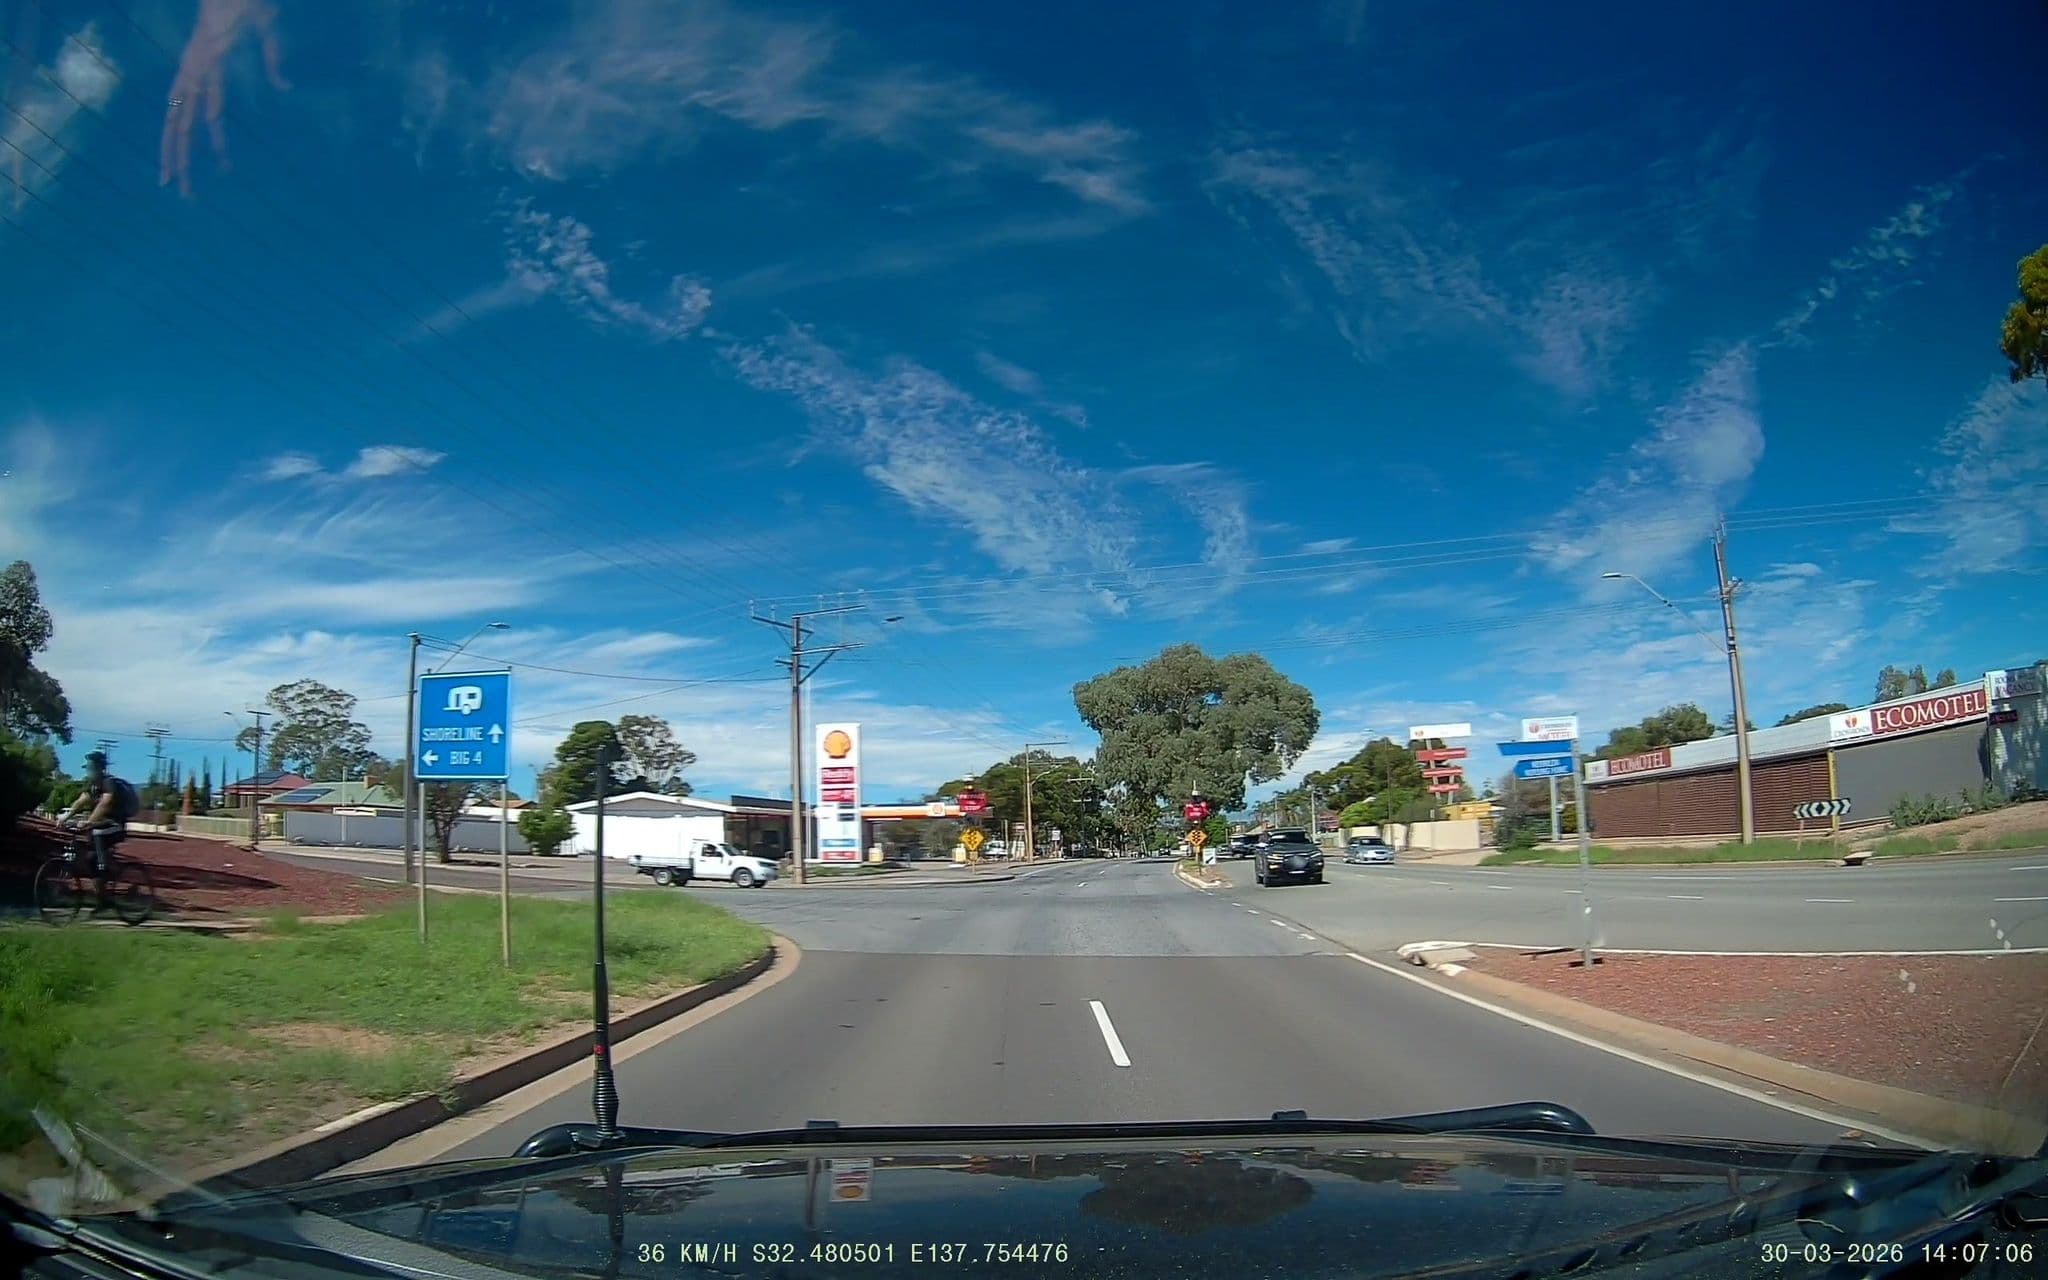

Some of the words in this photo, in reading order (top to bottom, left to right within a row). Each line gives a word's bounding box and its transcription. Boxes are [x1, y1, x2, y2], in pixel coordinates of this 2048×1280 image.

[1876, 693, 1984, 728] ECOMOTEL
[422, 726, 484, 741] SHORELINE
[449, 751, 470, 765] BIG
[472, 751, 482, 765] 4
[1610, 752, 1666, 774] ECOMOTEL
